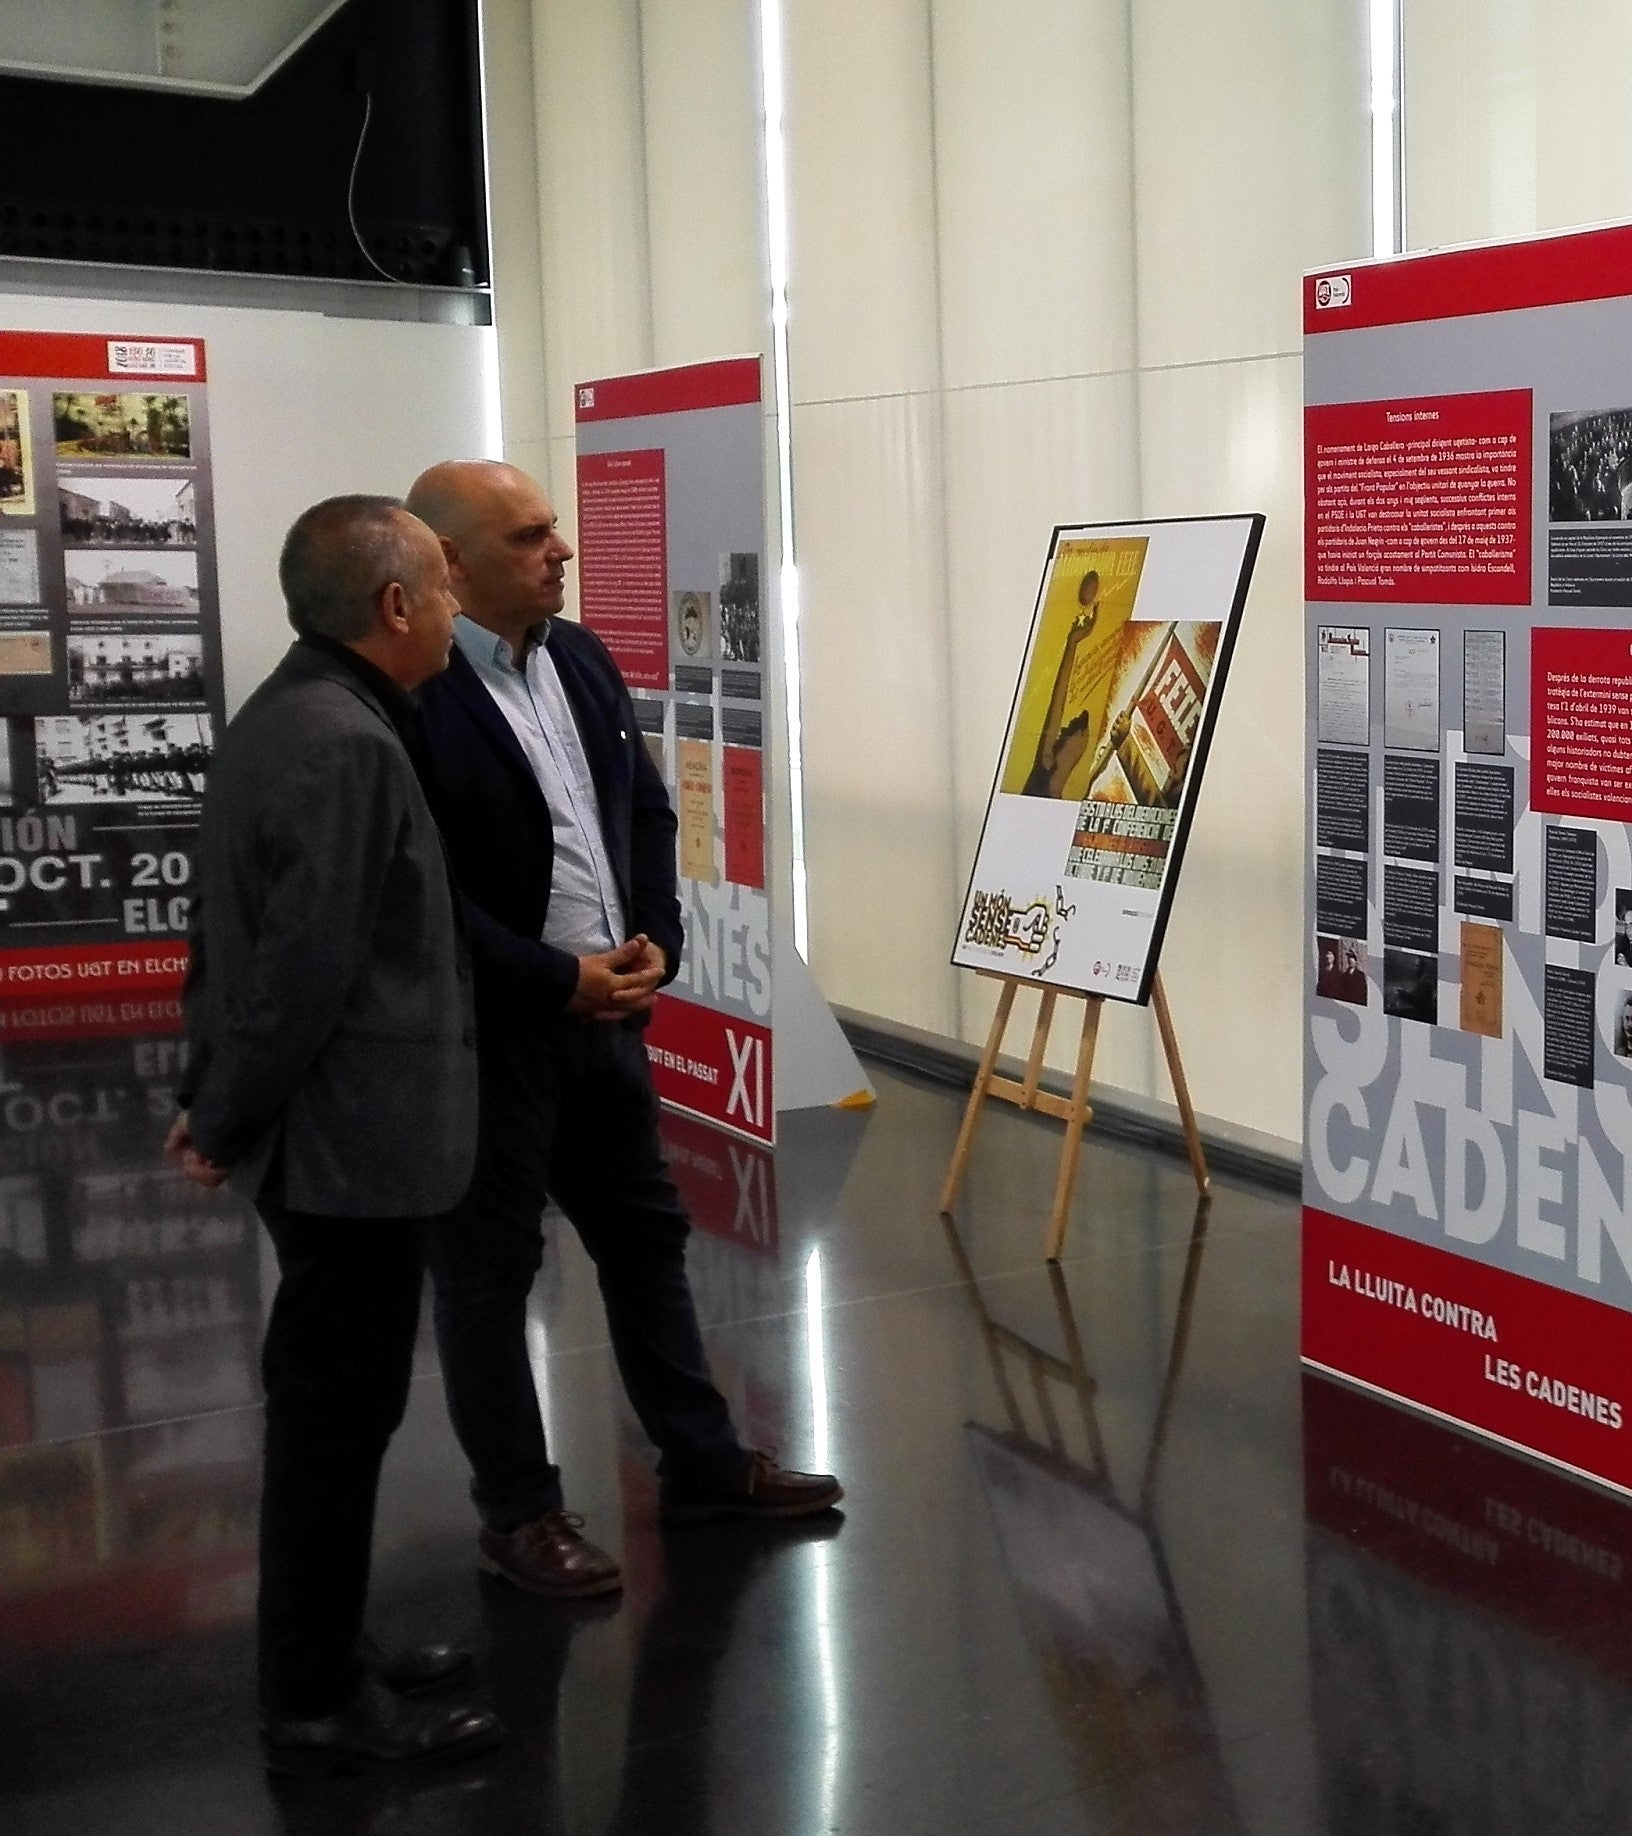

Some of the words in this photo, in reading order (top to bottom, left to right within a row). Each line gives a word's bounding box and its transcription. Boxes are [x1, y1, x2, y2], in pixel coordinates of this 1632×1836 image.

[1386, 411, 1412, 423] Tensions
[1414, 410, 1439, 421] internes
[1438, 451, 1453, 460] 1936
[0, 808, 76, 852] IÓN
[0, 855, 112, 892] OCT.
[130, 852, 190, 886] 20
[970, 906, 1011, 937] SENSE
[8, 964, 71, 981] FOTOS
[77, 960, 112, 978] UGT
[117, 960, 140, 975] EN
[687, 1058, 718, 1085] PASSAT
[725, 1028, 764, 1128] XI
[1328, 1260, 1351, 1290] LA
[1354, 1269, 1417, 1314] LLUITA
[1421, 1293, 1498, 1342] CONTRA
[1485, 1355, 1522, 1391] LES
[1525, 1371, 1623, 1430] CADENES
